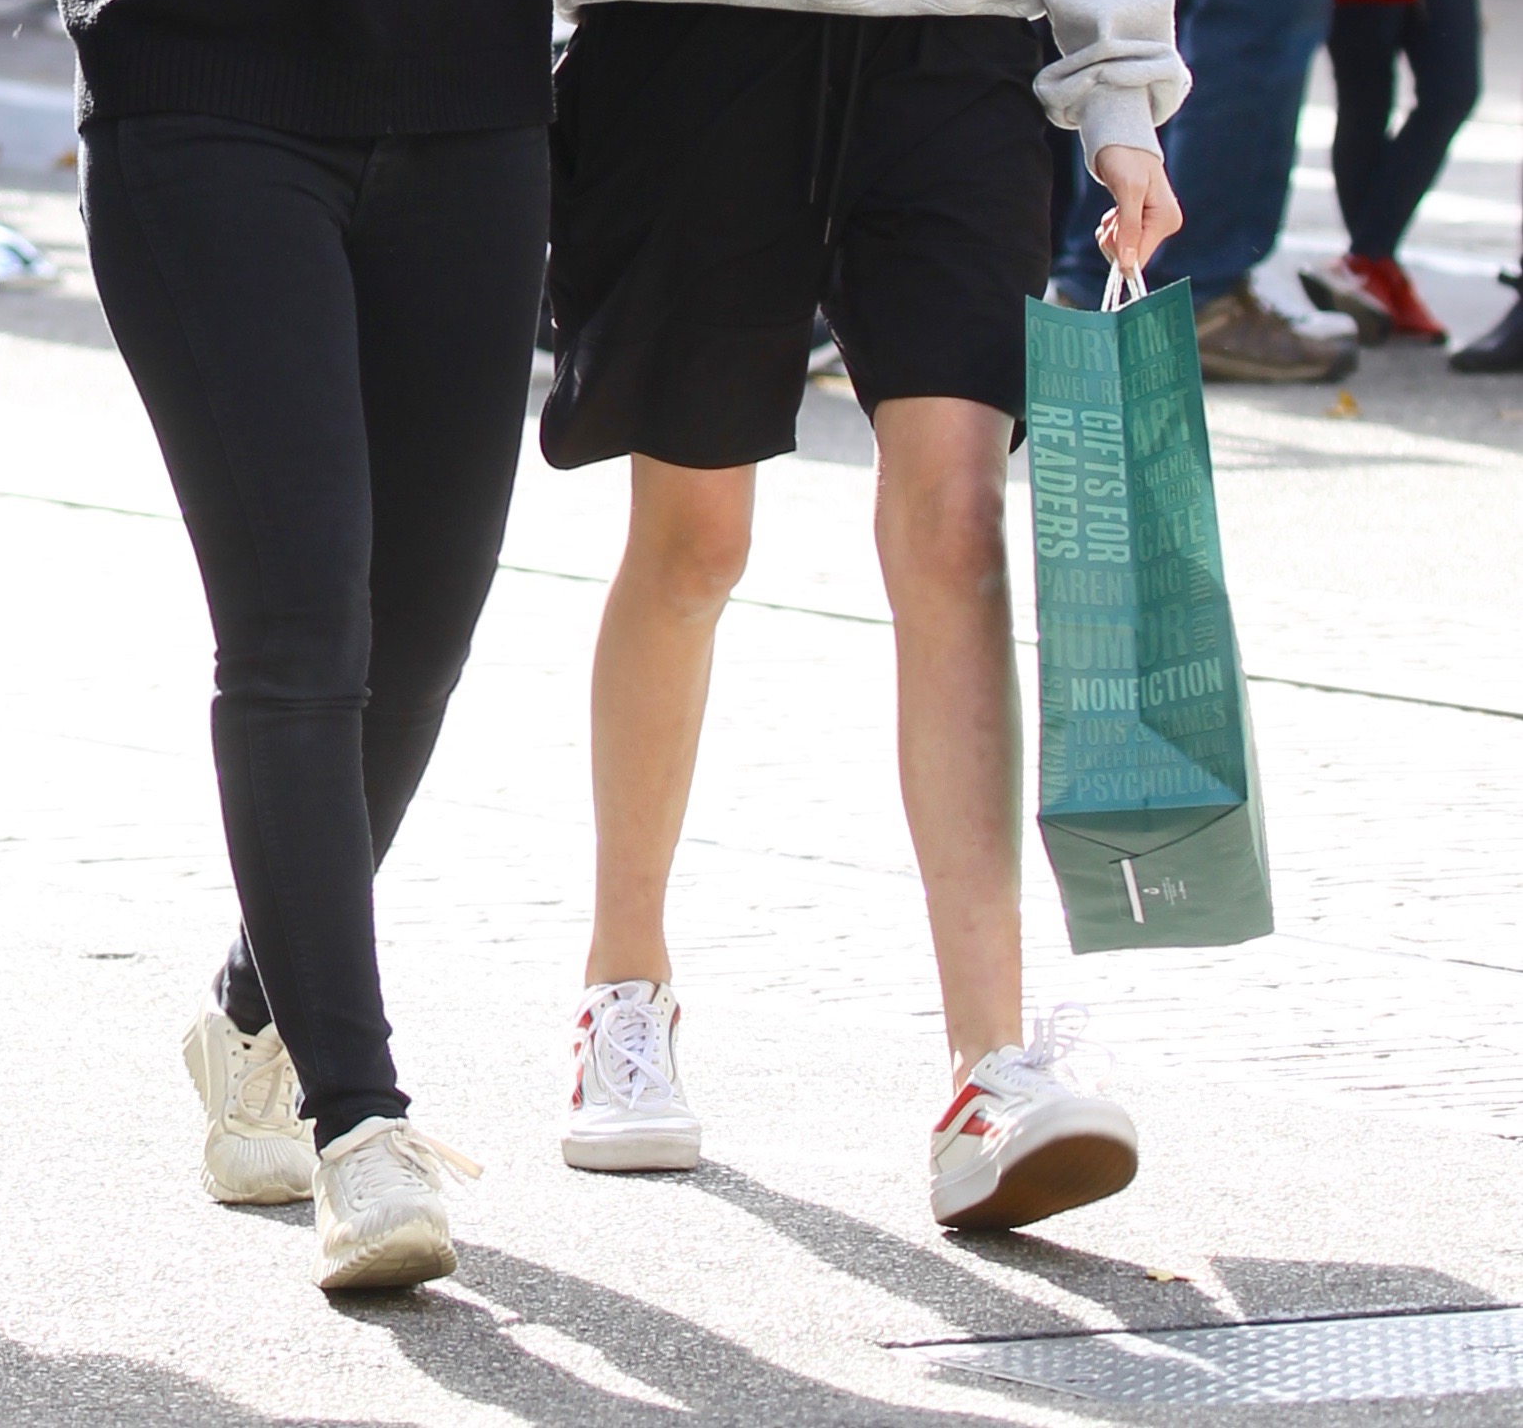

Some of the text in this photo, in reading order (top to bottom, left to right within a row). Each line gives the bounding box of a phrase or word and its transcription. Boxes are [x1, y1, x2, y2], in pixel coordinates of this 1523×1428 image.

[1029, 351, 1187, 404] TRAVEL REFERENCE
[1132, 389, 1190, 460] ART
[1030, 402, 1080, 559] READERS
[1079, 410, 1130, 563] GIFTS FOR
[1134, 447, 1201, 492] SCIENCE
[1135, 475, 1202, 515] RELIGION
[1039, 557, 1183, 606] PARENTING
[1187, 549, 1217, 653] THRILLERS
[1040, 603, 1189, 670] HUMOR
[1071, 657, 1223, 711] NONFICTION
[1072, 700, 1227, 746] TOYS & GAMES
[1075, 745, 1178, 770] EXCEPTIONAL
[1076, 758, 1233, 803] PSYCHOLOGY
